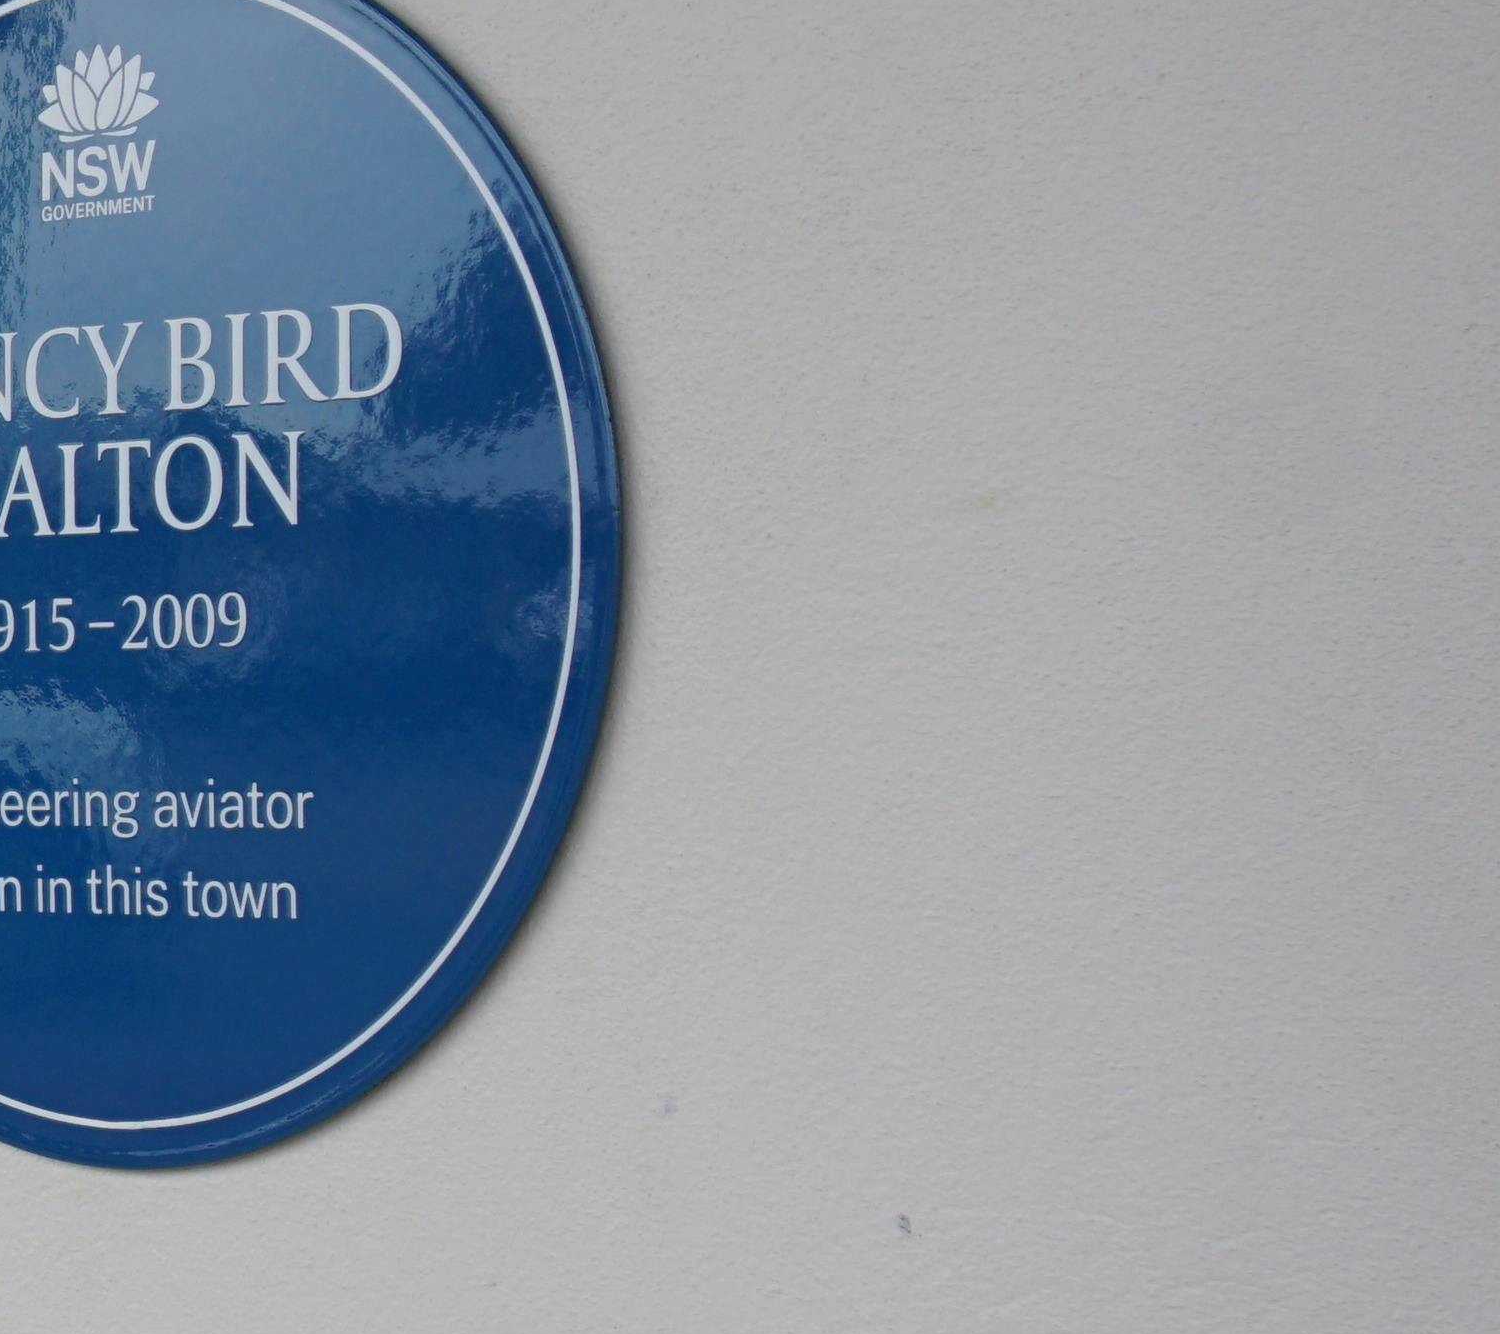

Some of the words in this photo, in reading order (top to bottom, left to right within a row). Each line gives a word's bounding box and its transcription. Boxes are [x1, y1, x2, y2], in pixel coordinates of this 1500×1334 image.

[41, 139, 156, 201] NSW
[41, 195, 156, 222] GOVERNMENT
[164, 302, 403, 412] BIRD
[153, 778, 314, 829] aviator
[36, 865, 73, 914] in
[86, 865, 169, 917] this
[182, 870, 298, 920] town
